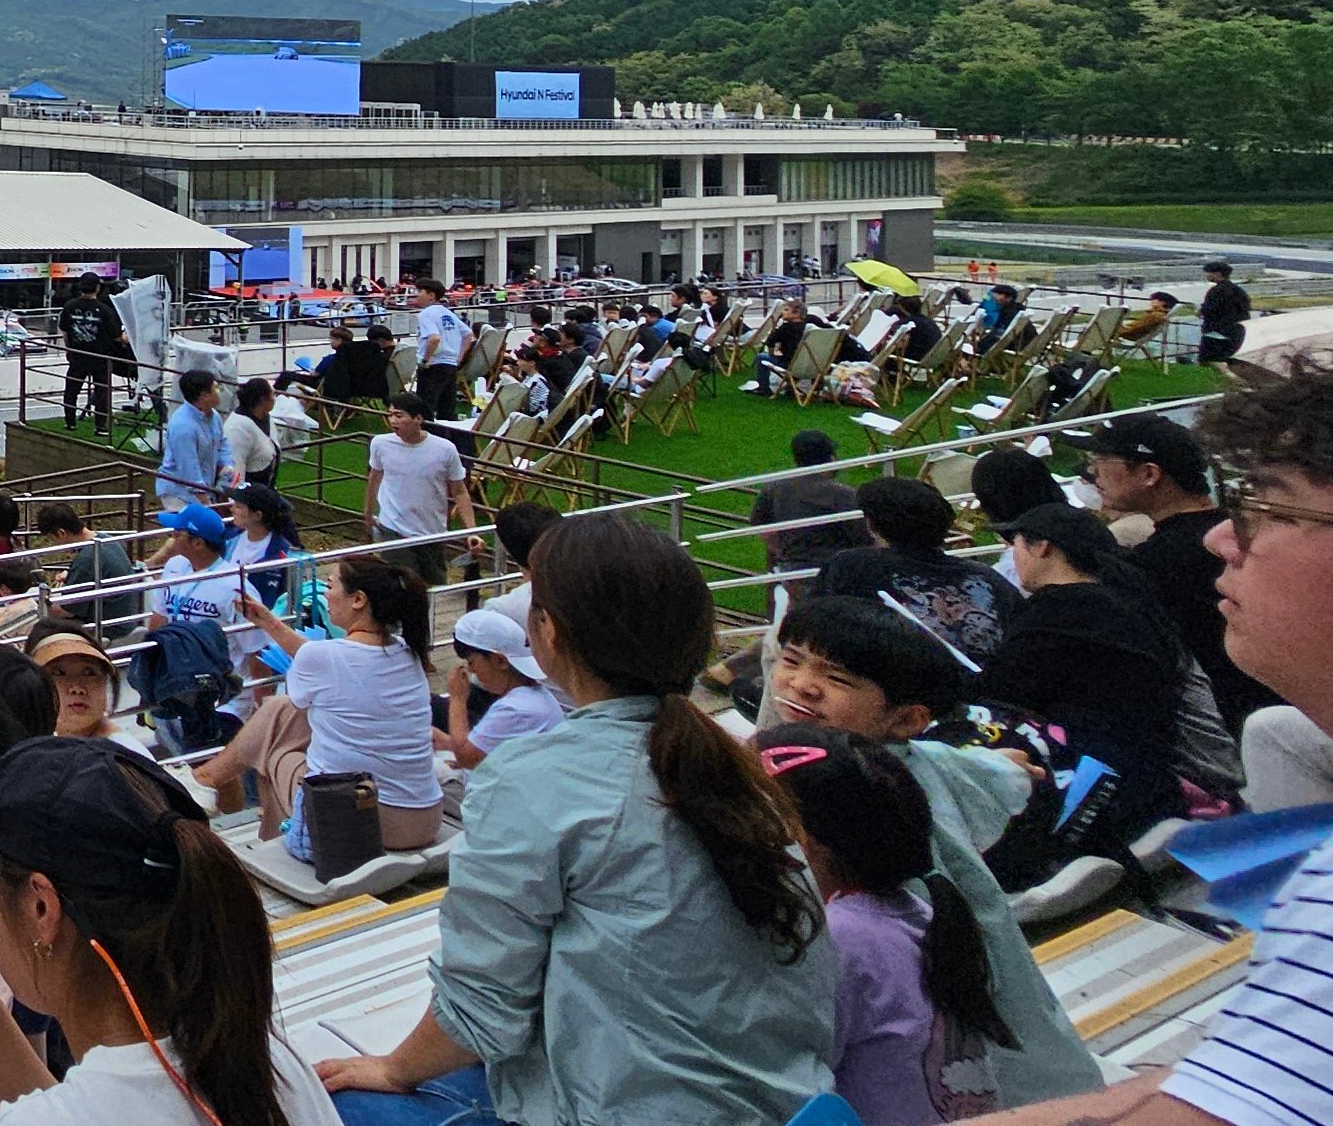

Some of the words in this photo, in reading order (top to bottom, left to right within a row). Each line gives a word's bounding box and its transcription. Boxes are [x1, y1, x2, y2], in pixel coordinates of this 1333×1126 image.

[500, 88, 536, 103] Hyundai
[537, 89, 544, 100] N
[545, 89, 575, 101] Festival
